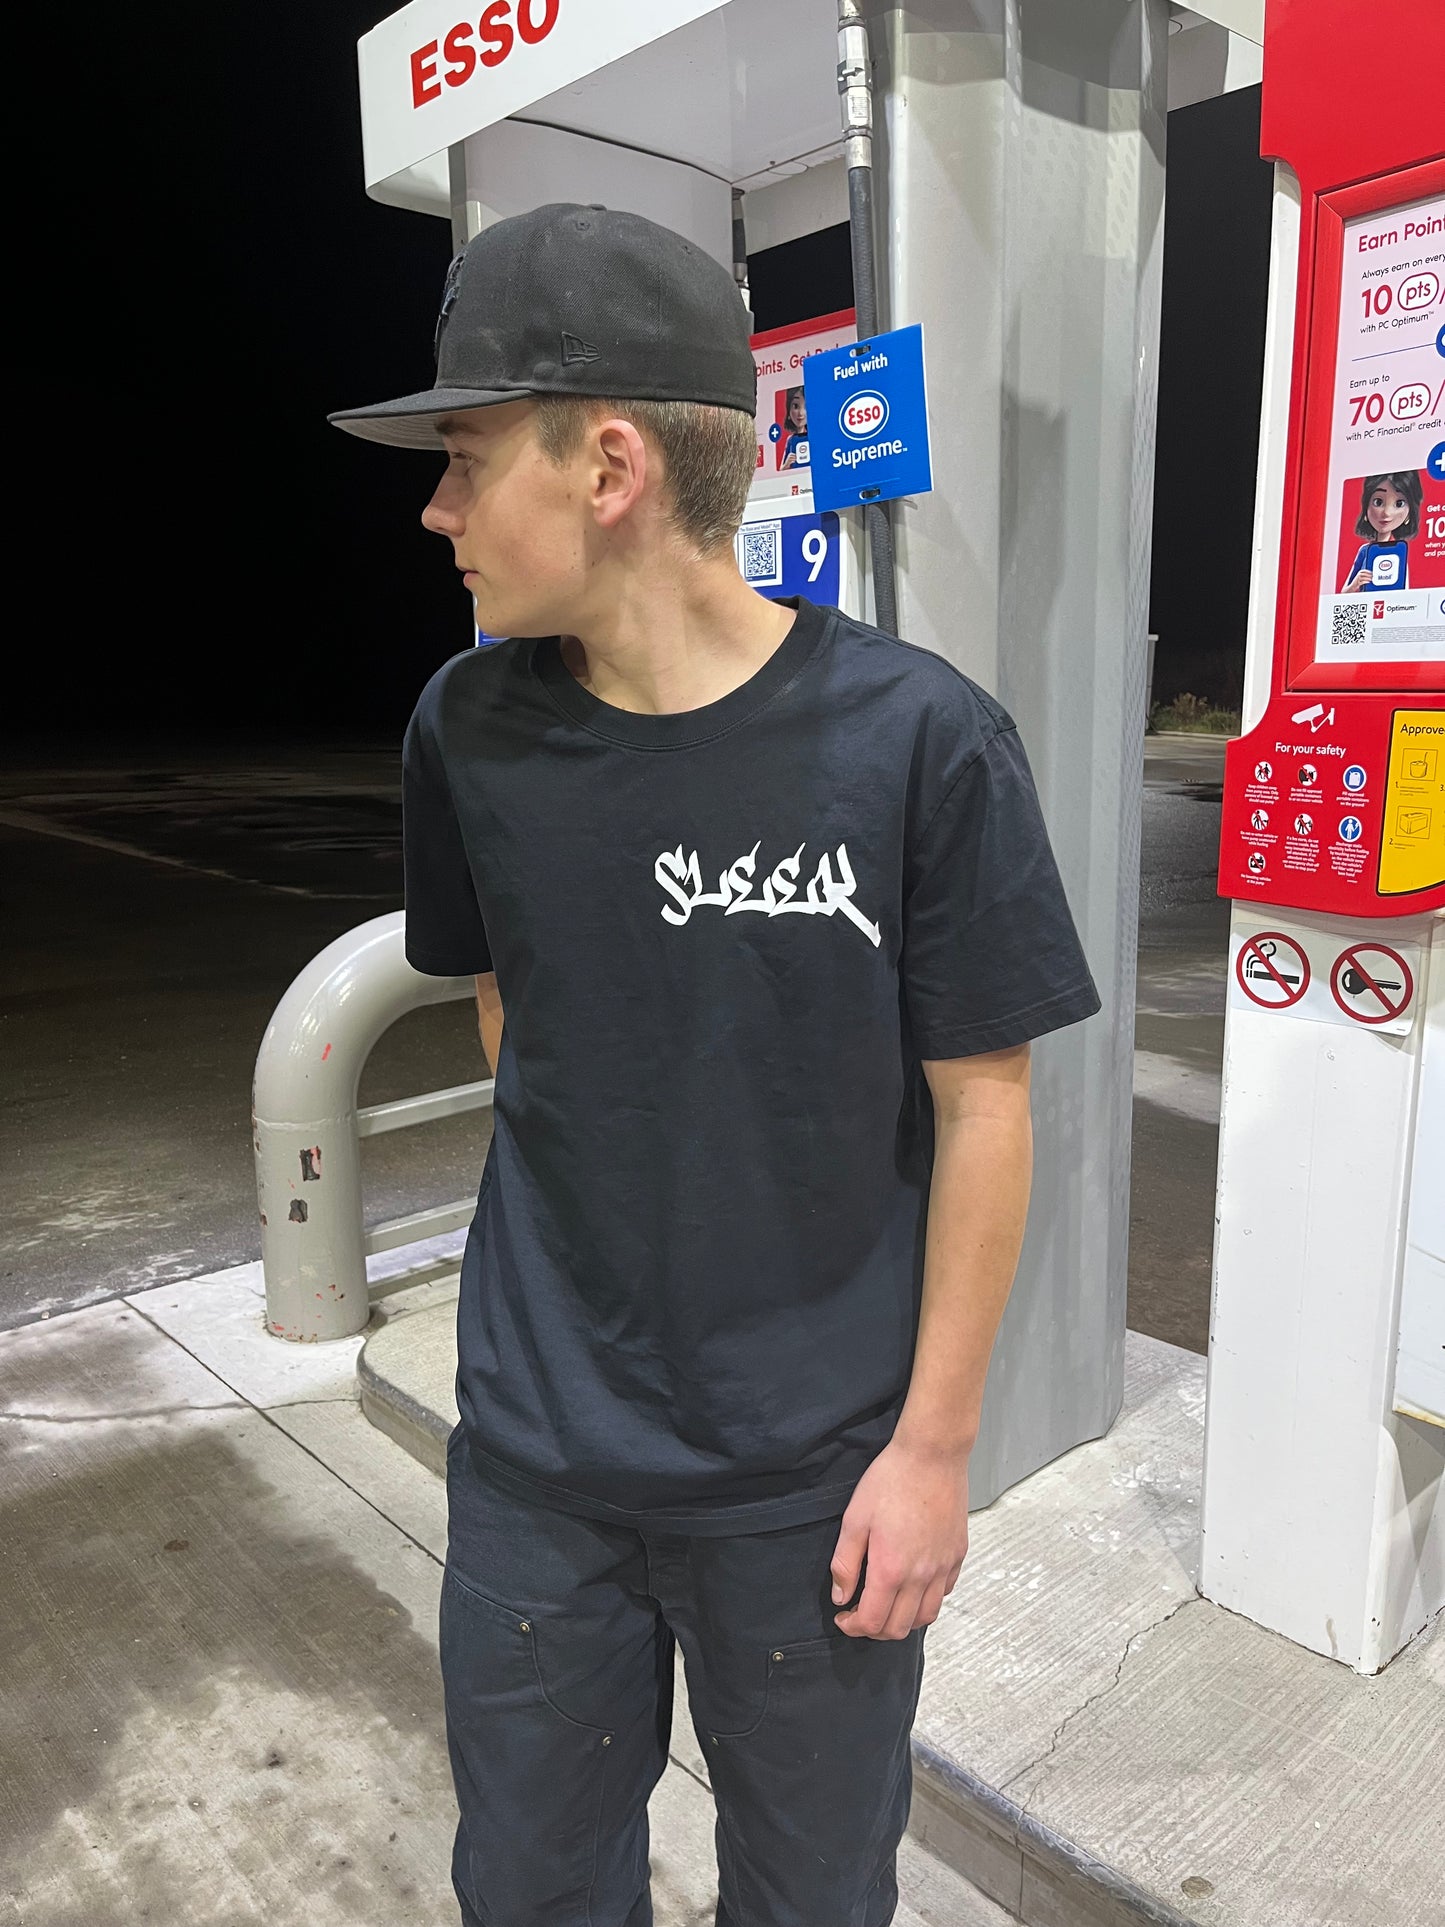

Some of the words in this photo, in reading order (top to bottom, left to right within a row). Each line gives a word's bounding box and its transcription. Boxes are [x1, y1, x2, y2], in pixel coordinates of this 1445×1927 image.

[410, 0, 560, 109] ESSO
[1358, 231, 1398, 252] Earn
[1361, 267, 1389, 280] Always
[1391, 262, 1410, 272] earn
[1412, 259, 1423, 267] on
[1361, 284, 1393, 318] 10
[1406, 281, 1431, 305] pts
[1359, 324, 1376, 334] with
[1378, 320, 1389, 330] PC
[833, 360, 859, 381] Fuel
[861, 353, 888, 373] with
[1349, 378, 1367, 389] Earn
[1369, 376, 1380, 387] up
[1381, 374, 1390, 383] to
[1349, 393, 1385, 426] 70
[1397, 391, 1423, 415] pts
[1346, 432, 1362, 441] with
[1363, 429, 1375, 438] PC
[1418, 419, 1442, 430] credit
[832, 439, 908, 470] Supreme.
[1426, 504, 1441, 513] Get
[802, 529, 828, 583] 9
[1400, 723, 1445, 737] Approve
[1275, 742, 1291, 752] For
[1293, 745, 1315, 756] your
[1316, 744, 1346, 759] safety
